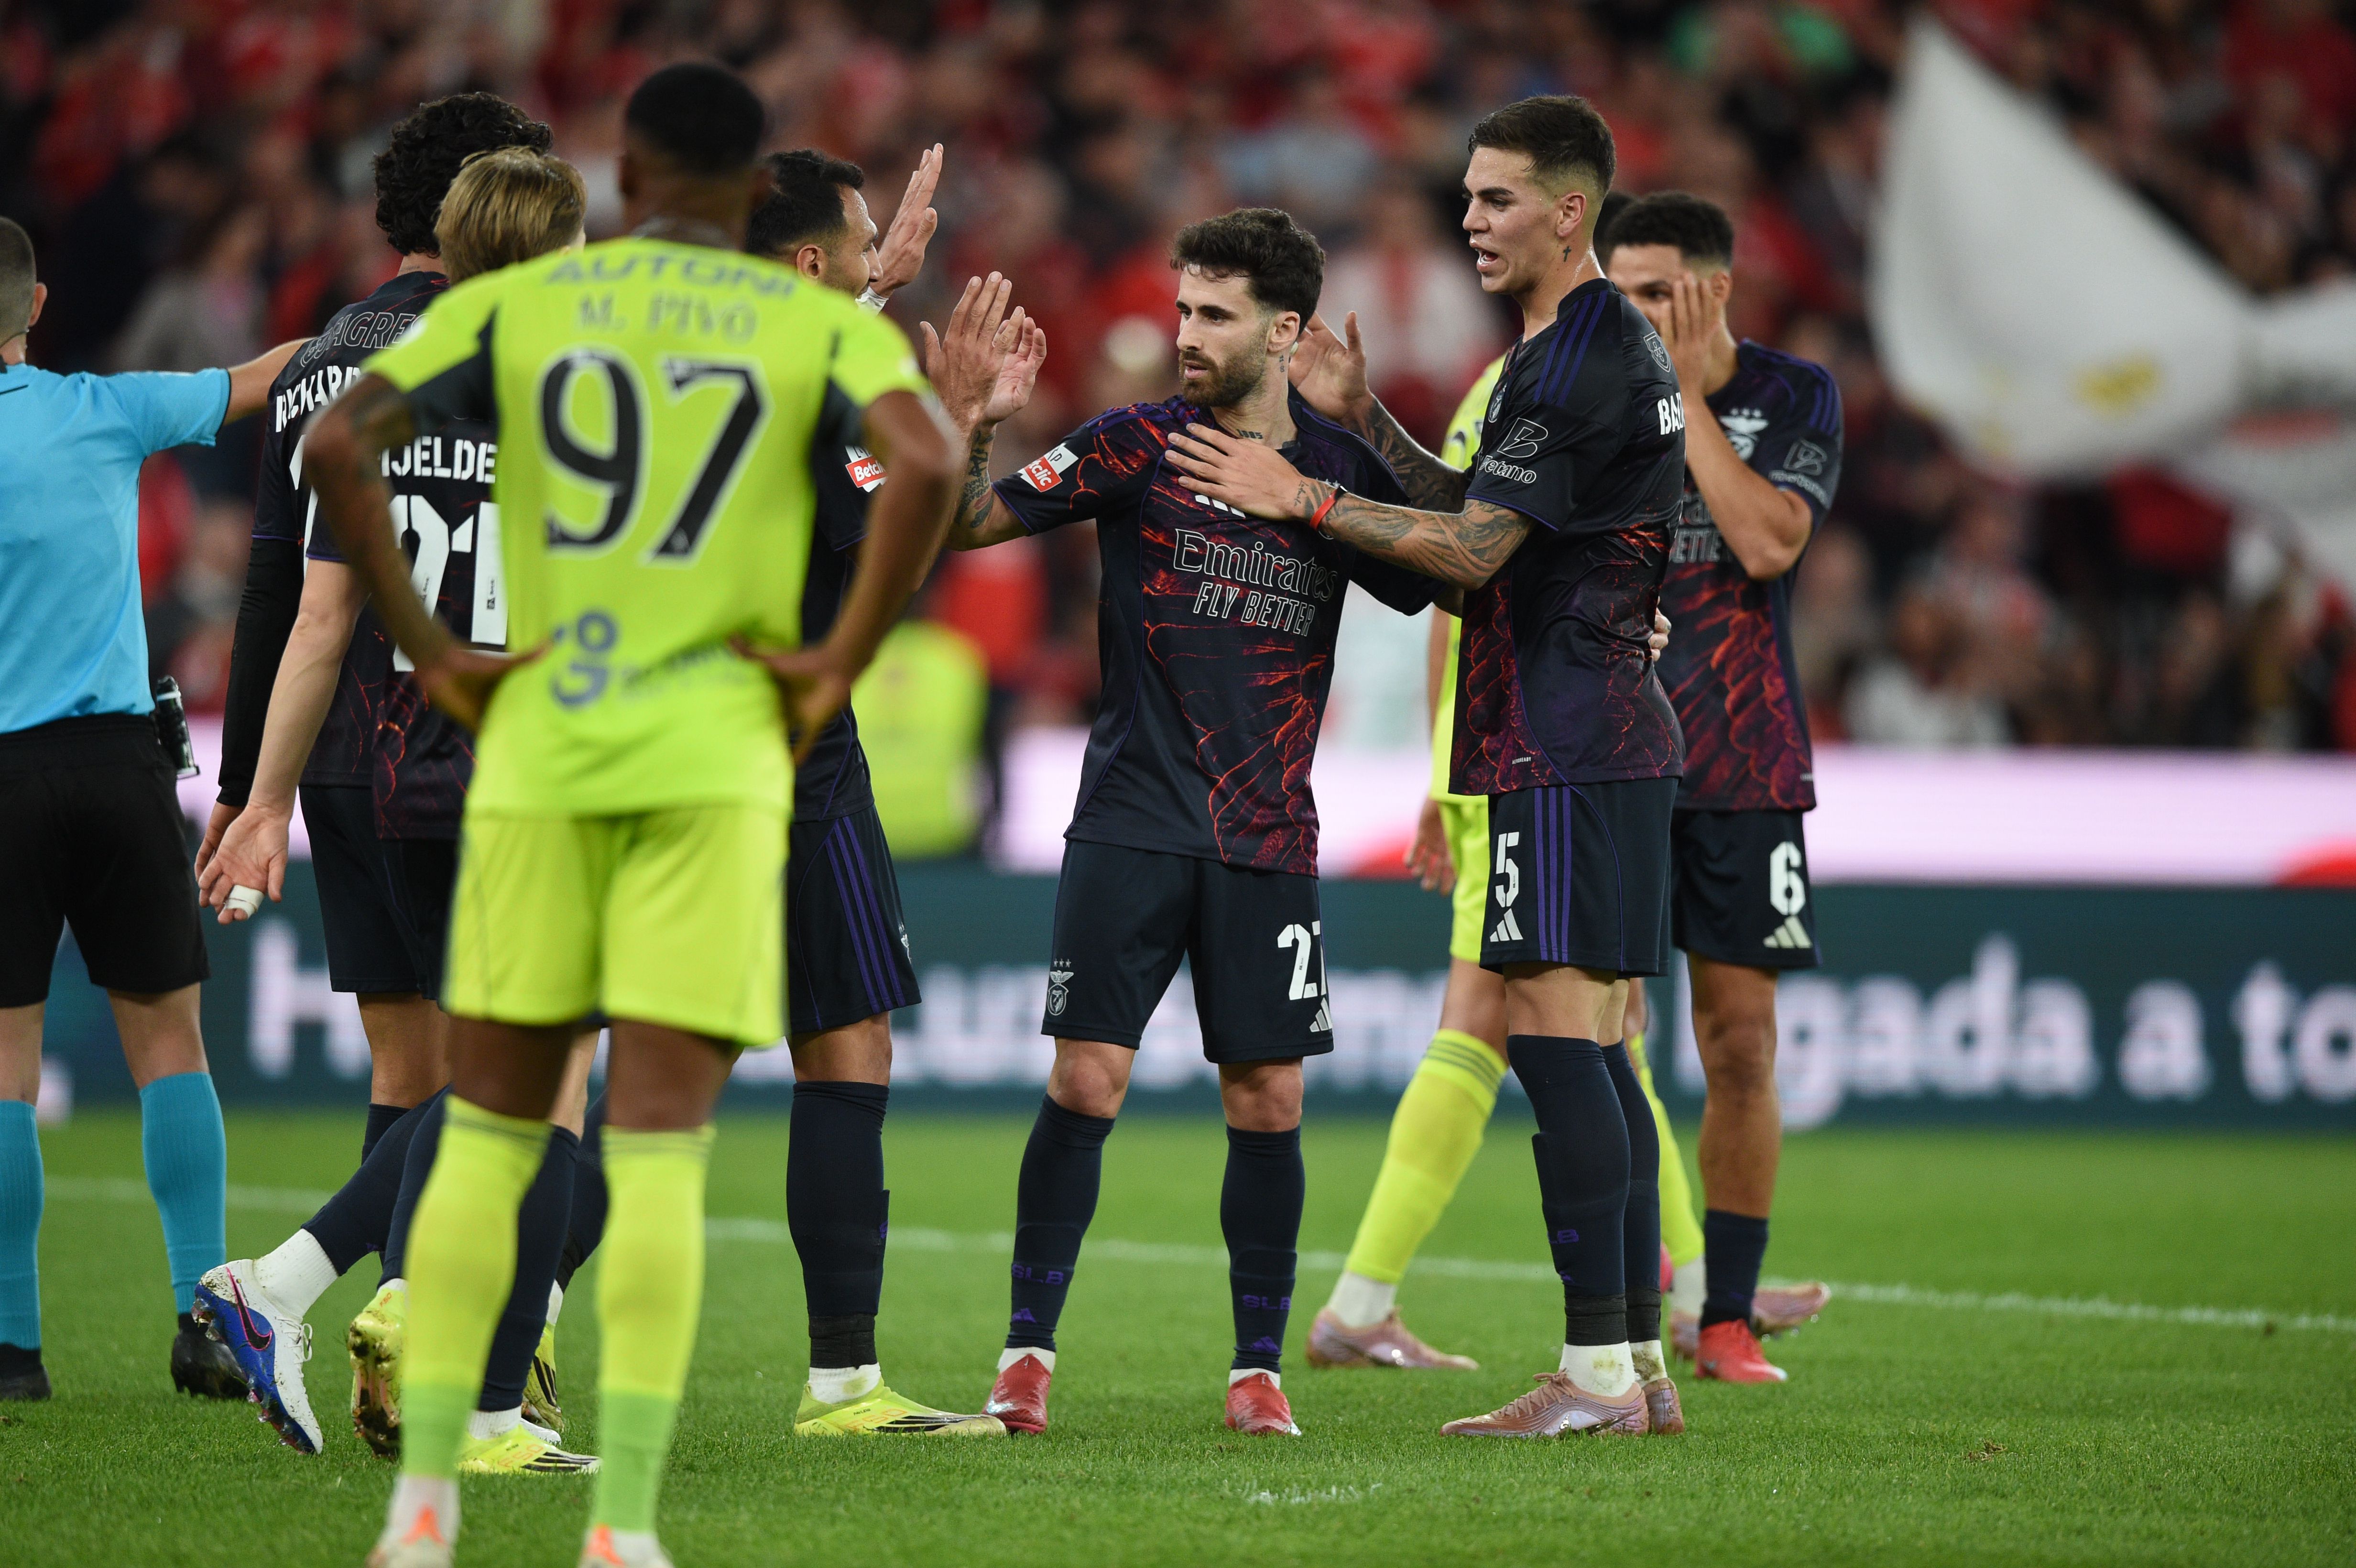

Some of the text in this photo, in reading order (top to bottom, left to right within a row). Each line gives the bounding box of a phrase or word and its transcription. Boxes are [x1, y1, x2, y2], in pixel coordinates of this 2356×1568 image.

[378, 436, 499, 484] JELDE
[534, 348, 771, 560] 97
[1173, 528, 1338, 602] Emirates
[1193, 581, 1315, 637] FLY BETTER
[1495, 831, 1519, 908] 5
[1769, 841, 1806, 916] 6
[1012, 1263, 1064, 1285] SLB
[1242, 1294, 1291, 1310] SLB
